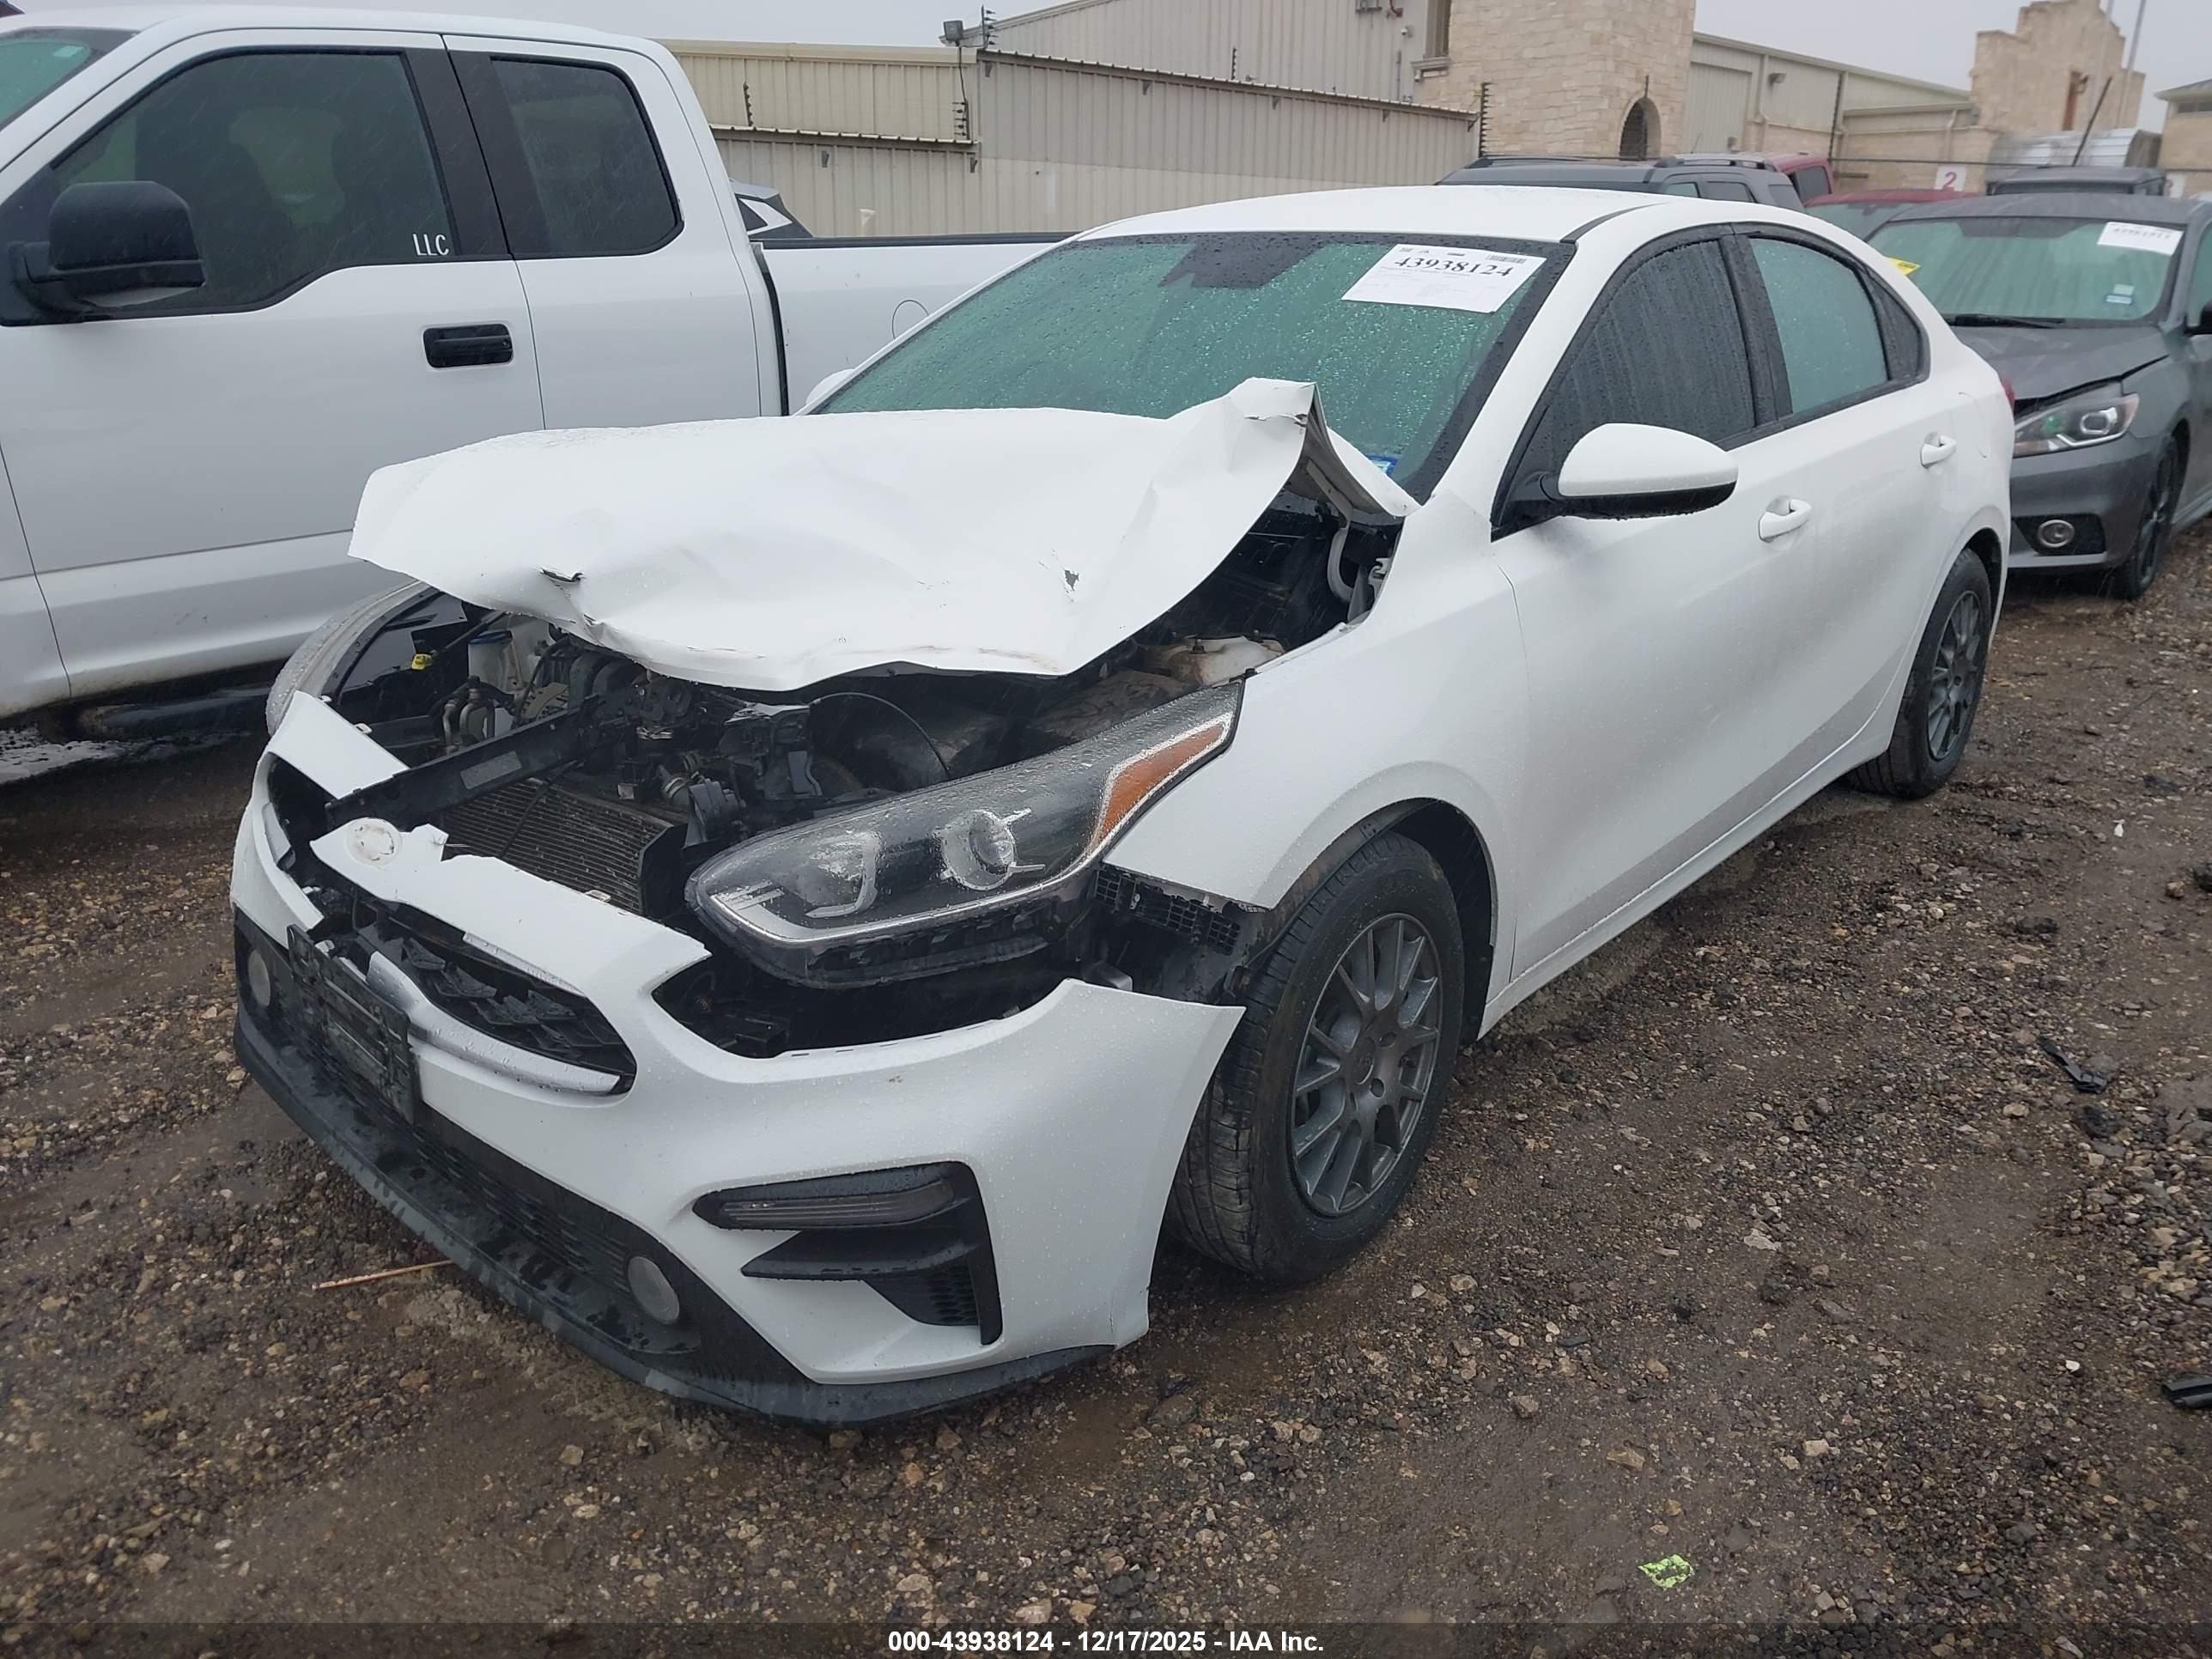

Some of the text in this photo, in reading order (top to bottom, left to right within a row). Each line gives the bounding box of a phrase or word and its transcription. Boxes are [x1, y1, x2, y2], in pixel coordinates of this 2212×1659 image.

[1940, 171, 1958, 192] 2
[412, 233, 450, 257] LLC
[1394, 256, 1514, 276] 43938124
